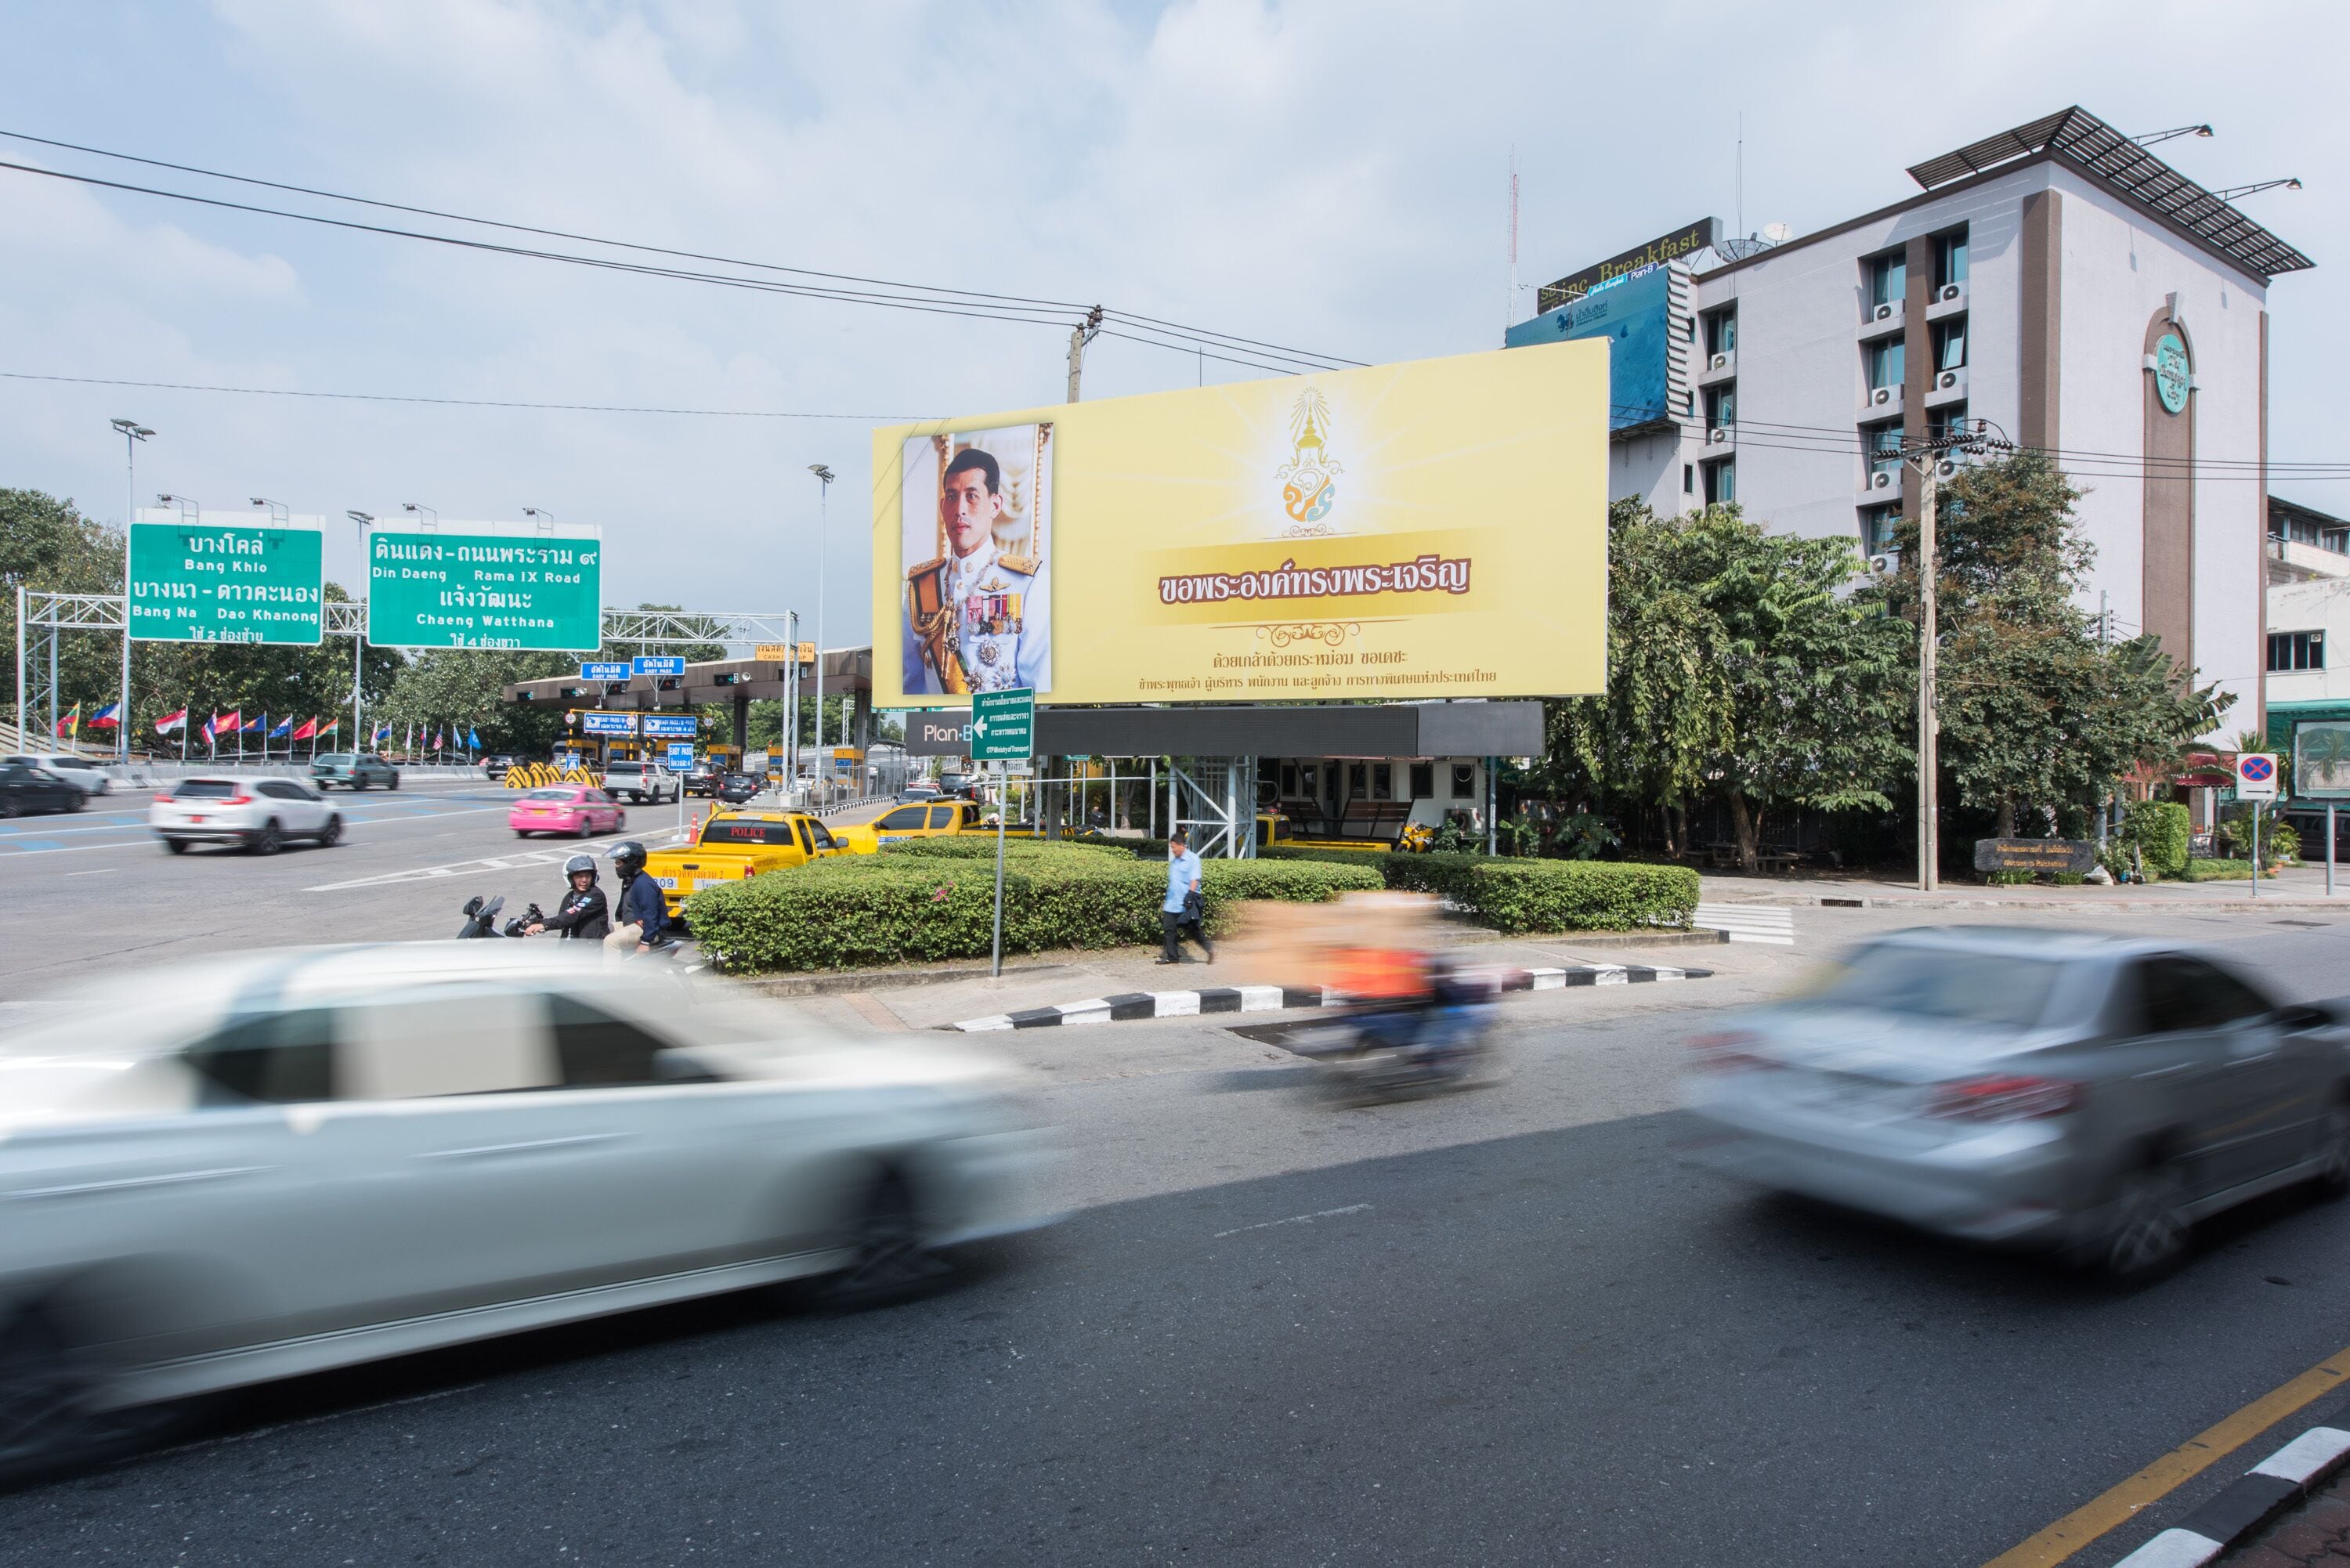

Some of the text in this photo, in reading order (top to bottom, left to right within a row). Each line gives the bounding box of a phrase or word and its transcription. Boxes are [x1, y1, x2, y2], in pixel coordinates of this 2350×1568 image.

[1599, 229, 1700, 281] Breakfast
[189, 532, 264, 555] บางโคล่
[184, 559, 267, 574] Bang Khlo
[372, 567, 580, 584] Din Daeng Rama IX Road
[1159, 555, 1470, 603] ขอพระองค์ทรงพระเจริญ
[133, 582, 197, 598] บางนา
[217, 584, 319, 603] ดาวคะนอง
[439, 584, 532, 609] แจ้งวัฒนะ
[132, 605, 318, 625] Bang Na Dao Khanong
[416, 614, 555, 629] Chaeng Watthana
[208, 631, 216, 641] 2
[220, 627, 263, 642] ช่องซ้าย
[468, 638, 477, 647] 4
[1213, 650, 1408, 668] ด้วยเกล้าด้วยกระหม่อม ขอเดชะ
[1139, 668, 1497, 692] ข้าพระพุทธเจ้า ผู้บริหาร พนักงาน และลูกจ้าง การทางพิเศษแห่งประเทศไทย
[730, 826, 765, 837] POLICE
